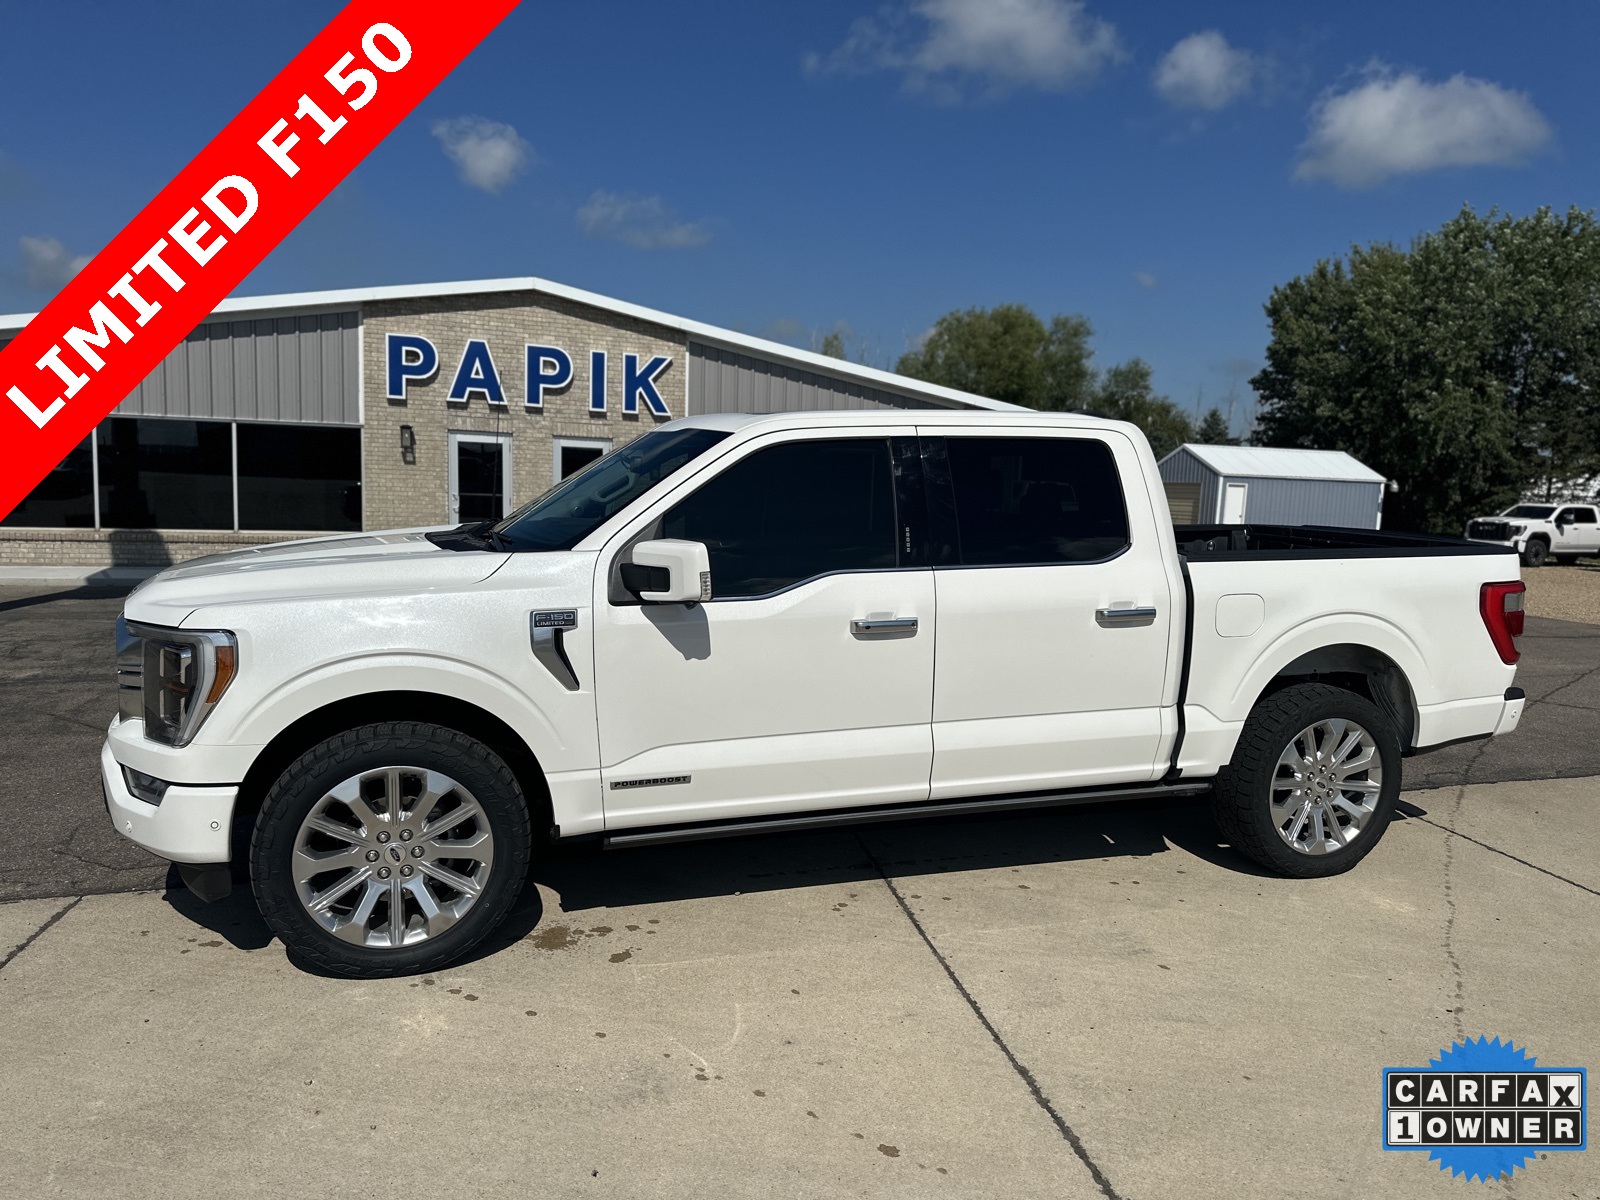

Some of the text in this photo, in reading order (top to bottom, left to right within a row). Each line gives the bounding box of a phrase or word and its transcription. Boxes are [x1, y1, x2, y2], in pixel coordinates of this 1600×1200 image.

[385, 332, 673, 416] PAPIK
[535, 613, 574, 621] F-150
[614, 776, 688, 788] POWERBOOST
